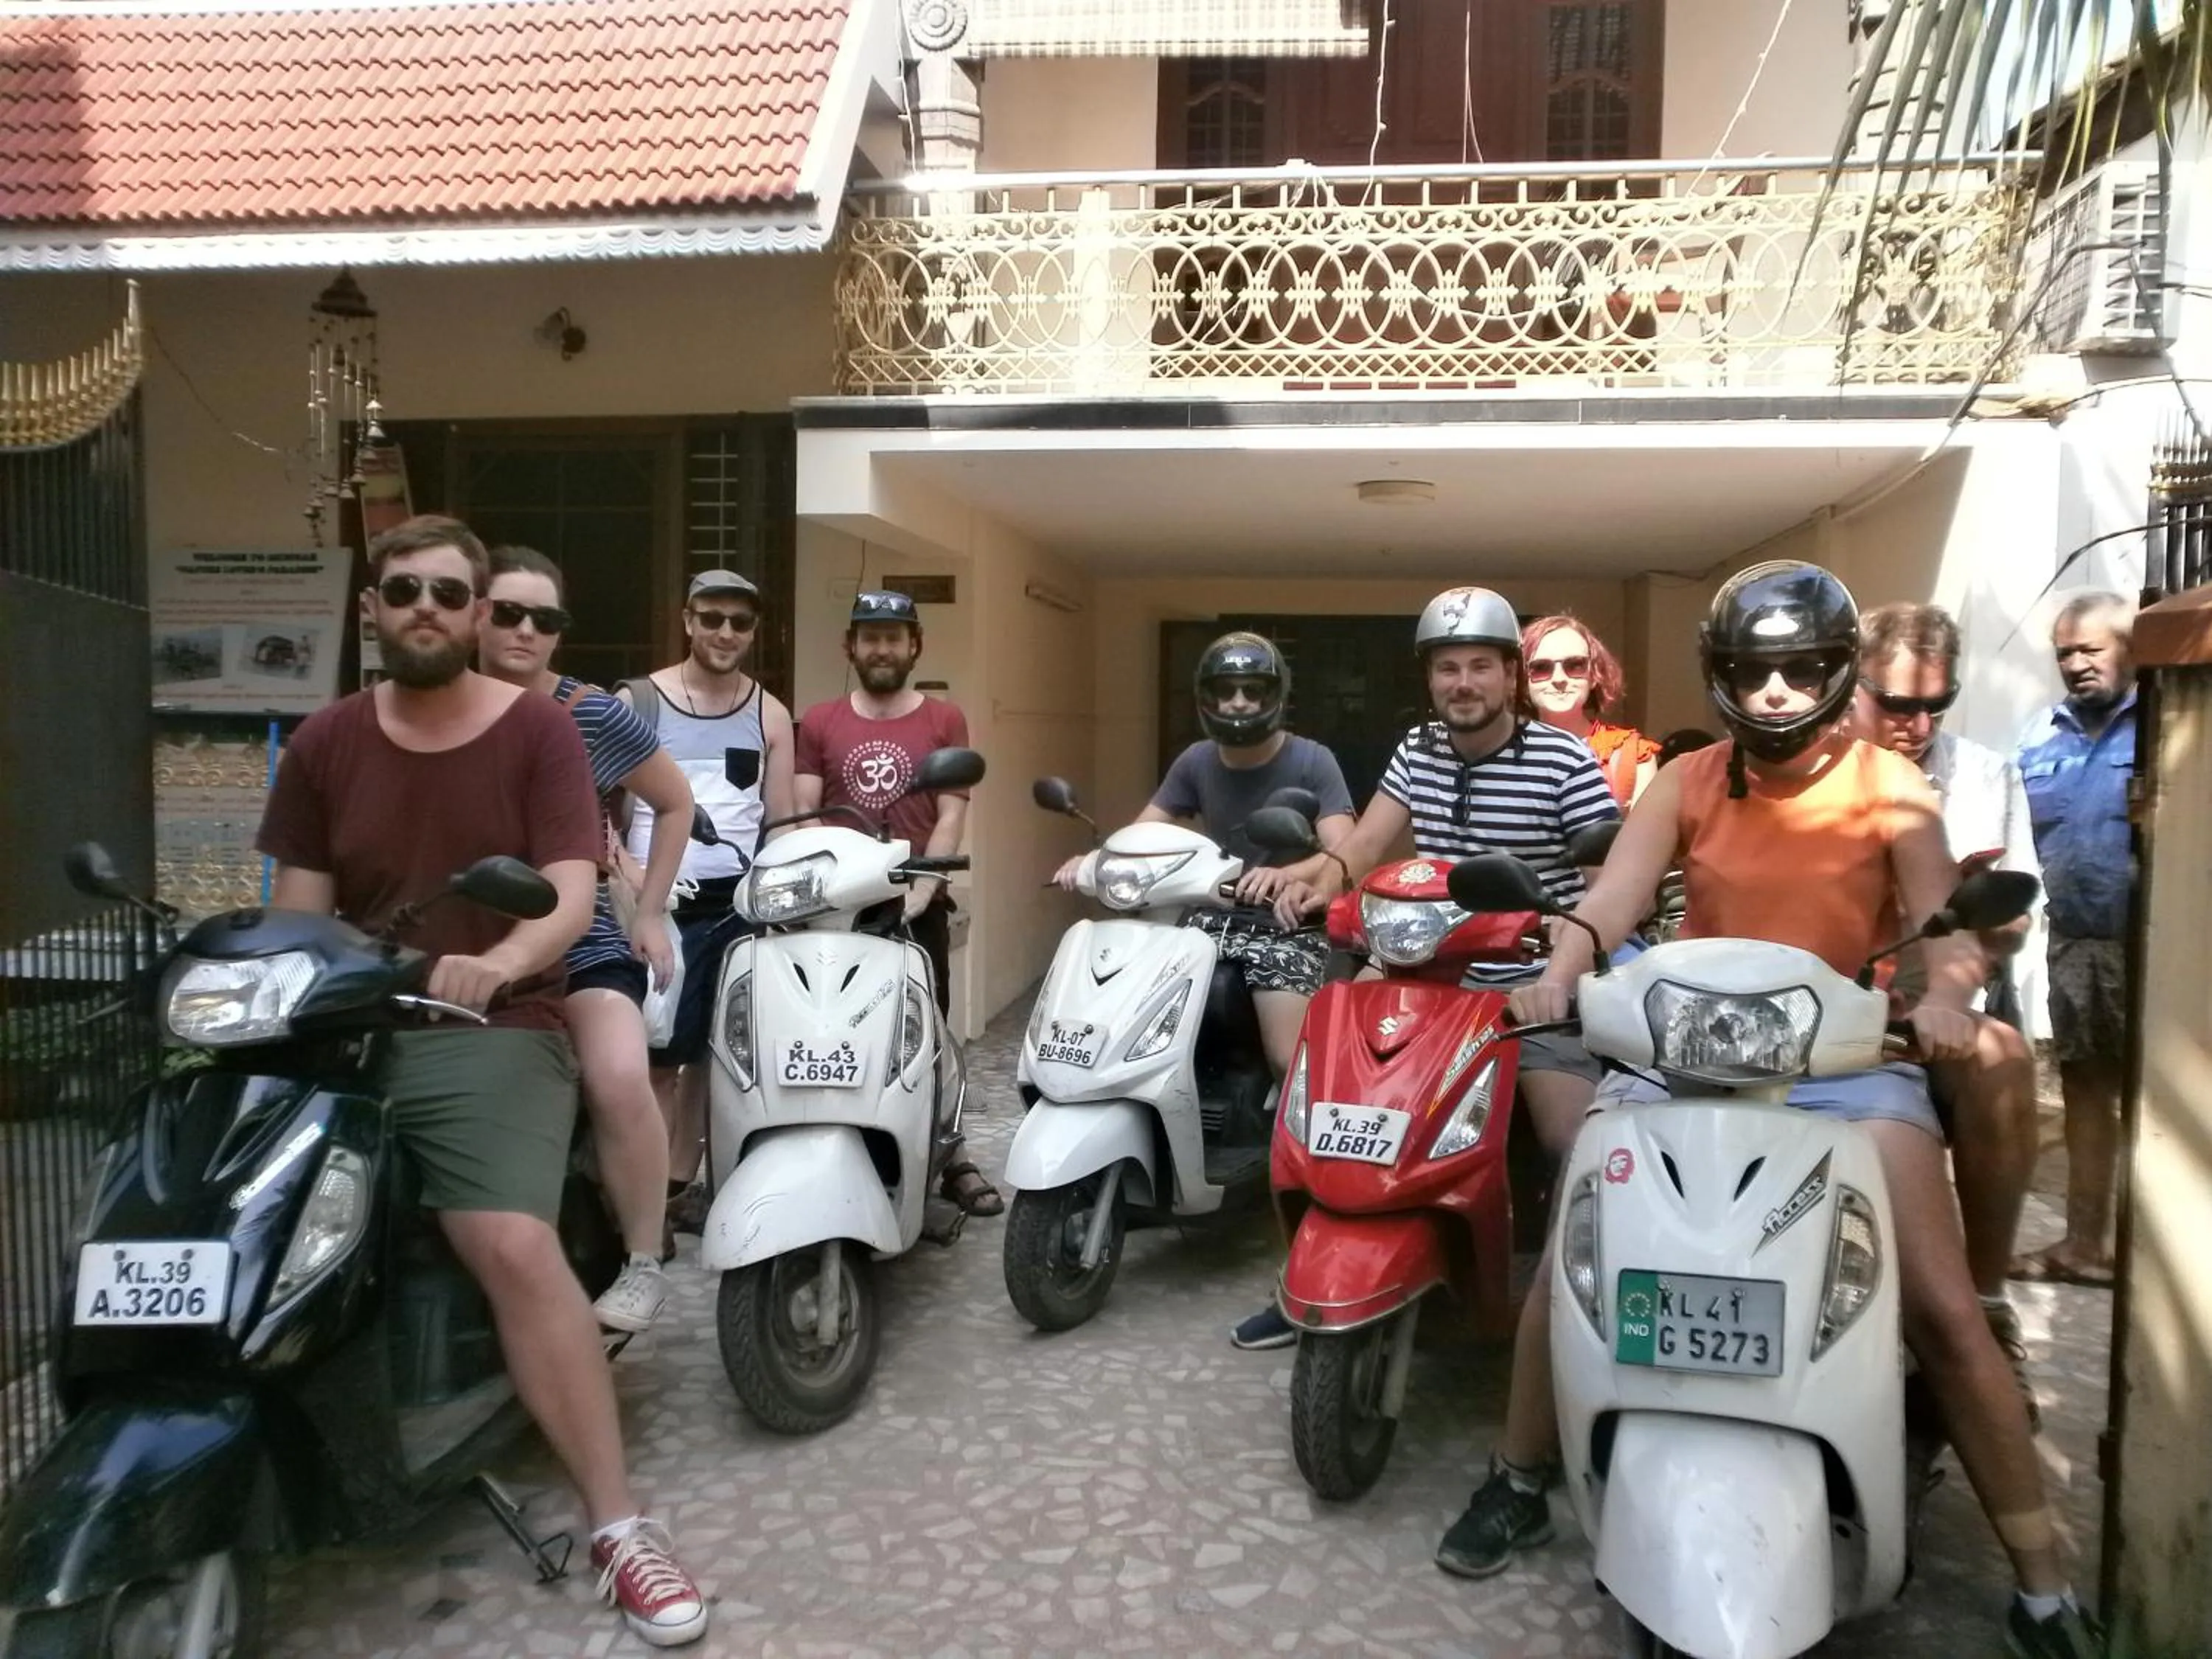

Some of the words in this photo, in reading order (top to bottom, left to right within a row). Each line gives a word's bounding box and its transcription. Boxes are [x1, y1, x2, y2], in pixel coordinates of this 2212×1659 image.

[788, 1049, 855, 1063] KL.43
[1038, 1043, 1092, 1064] BU-8696
[785, 1064, 858, 1082] C.6947
[1332, 1119, 1382, 1135] KL.39
[1315, 1133, 1393, 1158] D.6817
[115, 1262, 191, 1284] KL.39
[88, 1287, 206, 1318] A.3206
[1624, 1324, 1649, 1337] IND
[1660, 1326, 1676, 1355] G
[1688, 1329, 1770, 1365] 5273
